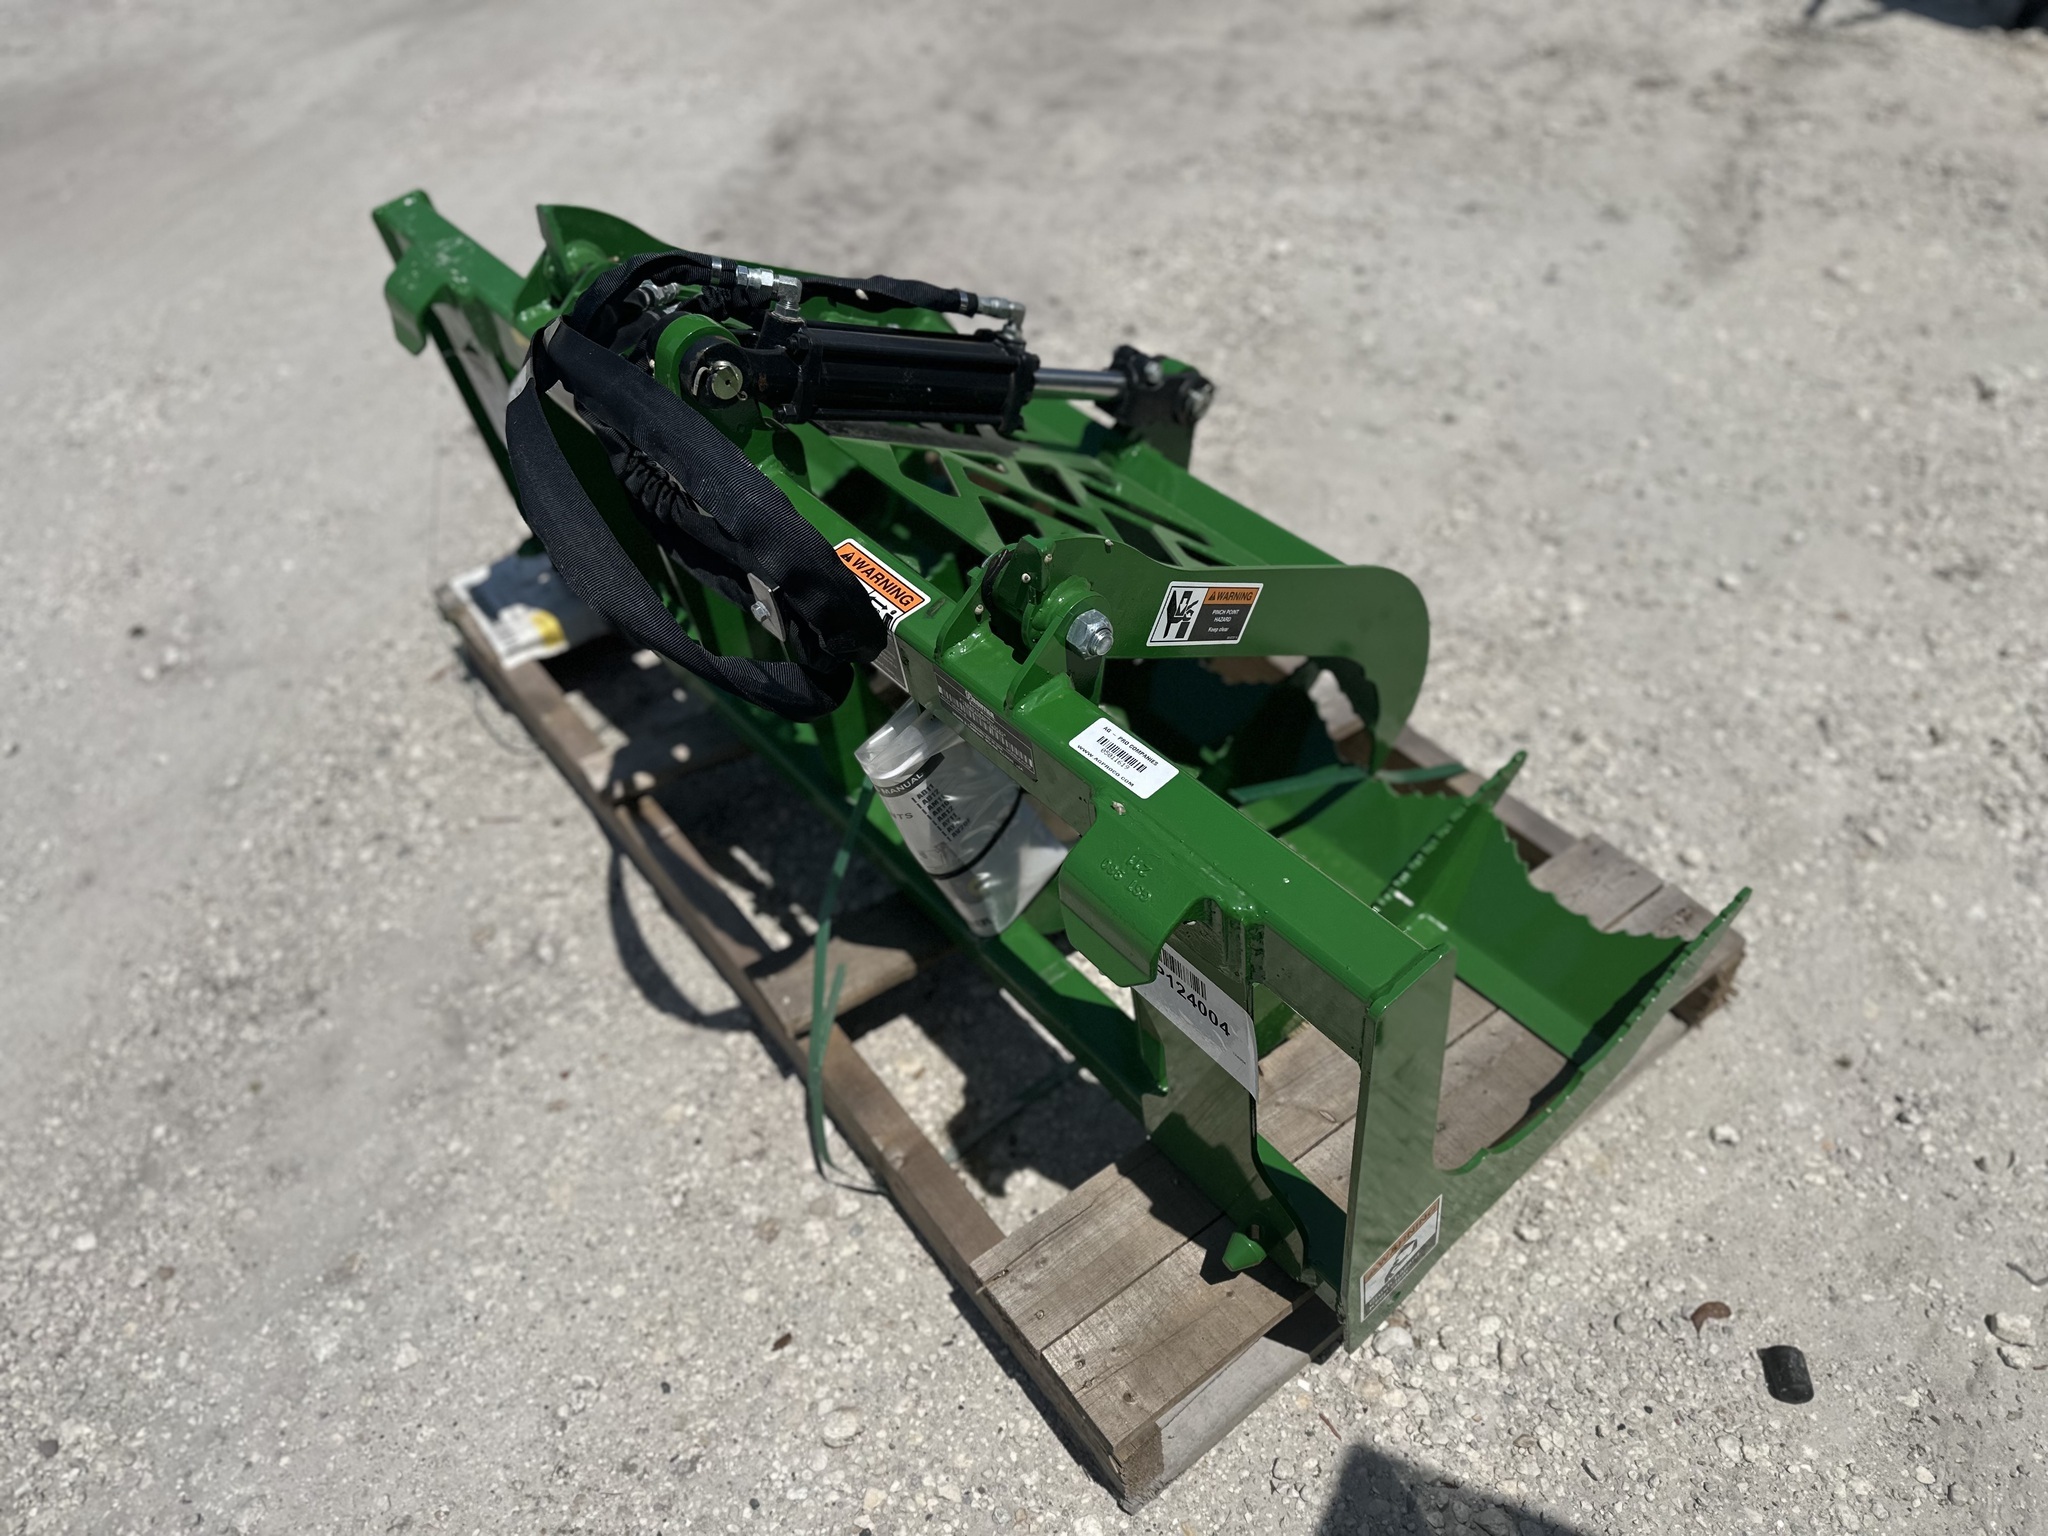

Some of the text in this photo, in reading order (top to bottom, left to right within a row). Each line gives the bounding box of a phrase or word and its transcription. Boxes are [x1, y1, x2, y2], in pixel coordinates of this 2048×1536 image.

[852, 557, 914, 607] WARNING
[1216, 592, 1253, 601] WARNING
[1117, 736, 1130, 746] PRO
[1129, 744, 1159, 766] COMPANIES
[880, 772, 924, 795] MANUAL
[1377, 1203, 1438, 1266] WARNING
